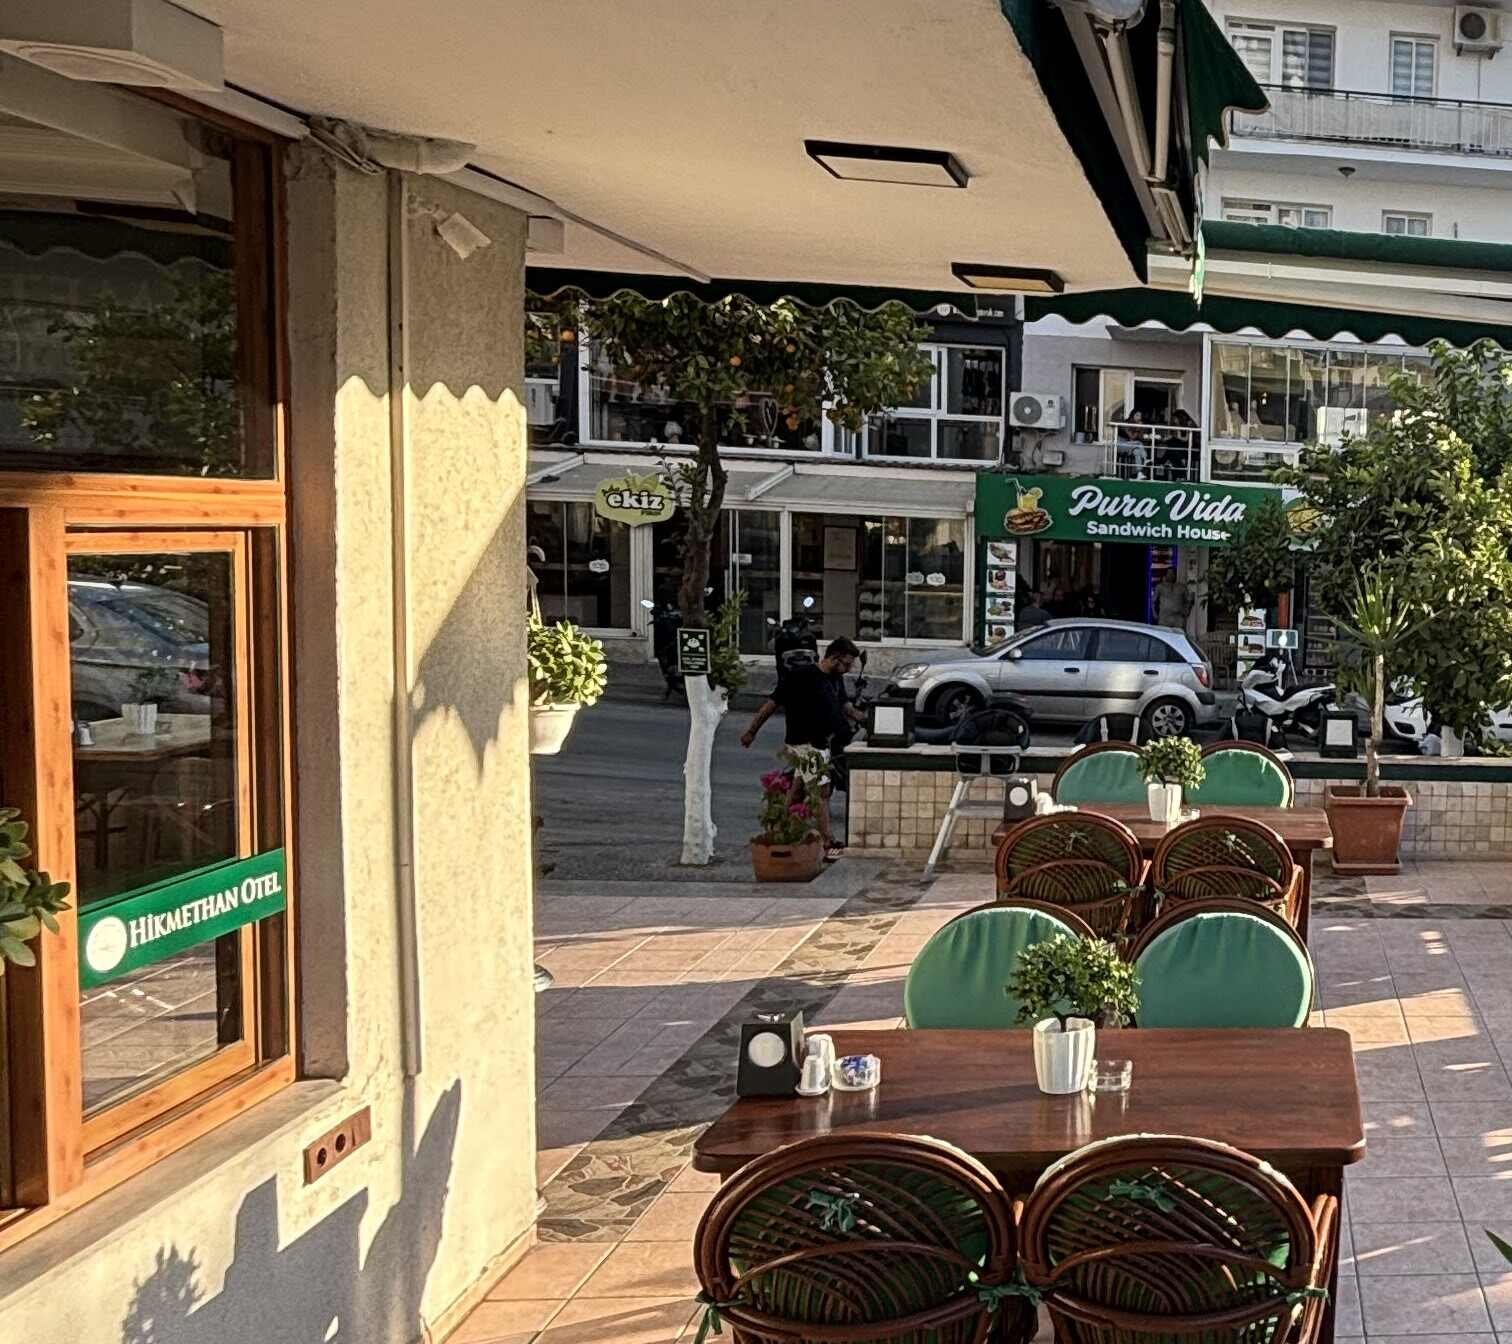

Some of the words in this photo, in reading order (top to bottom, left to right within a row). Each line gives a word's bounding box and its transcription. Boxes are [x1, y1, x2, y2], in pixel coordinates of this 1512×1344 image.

[607, 490, 664, 509] ekiz
[1068, 484, 1160, 516] Pura
[1164, 489, 1247, 522] Vida
[1086, 520, 1173, 539] Sandwich
[1177, 524, 1232, 541] House
[240, 871, 281, 904] OTEL
